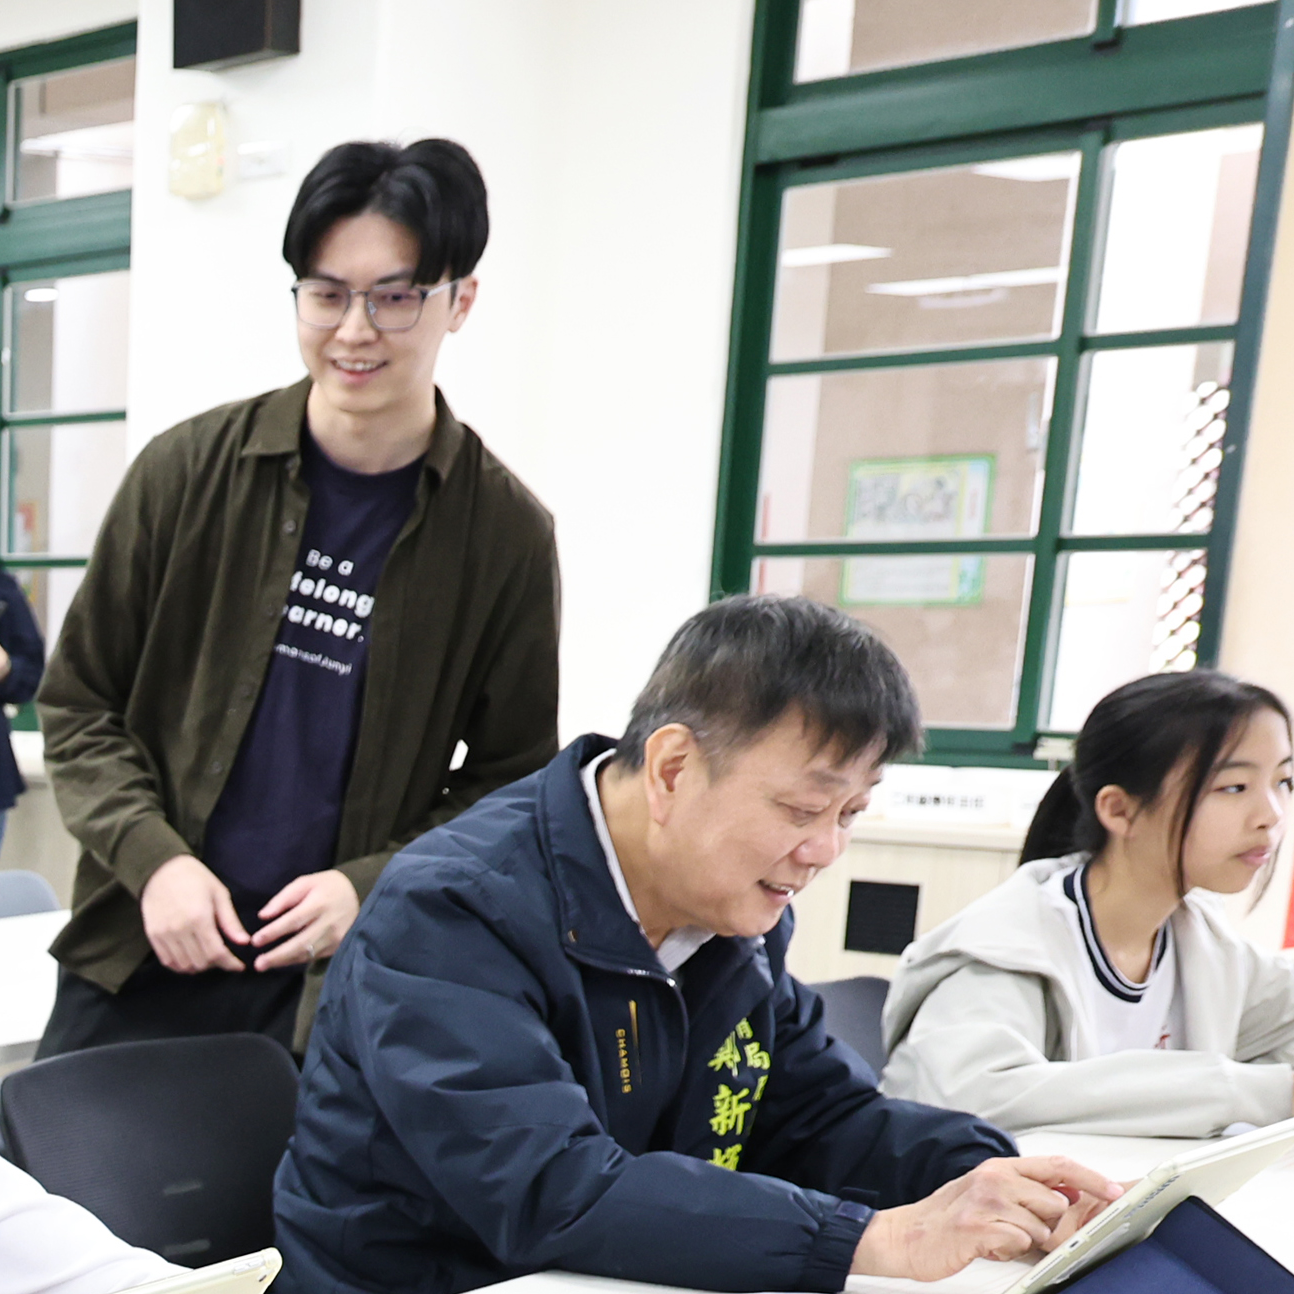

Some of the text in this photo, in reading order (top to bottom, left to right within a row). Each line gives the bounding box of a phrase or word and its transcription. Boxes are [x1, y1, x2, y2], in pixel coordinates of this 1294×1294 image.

[306, 549, 354, 576] Be a
[615, 1028, 632, 1094] CHAMOIS
